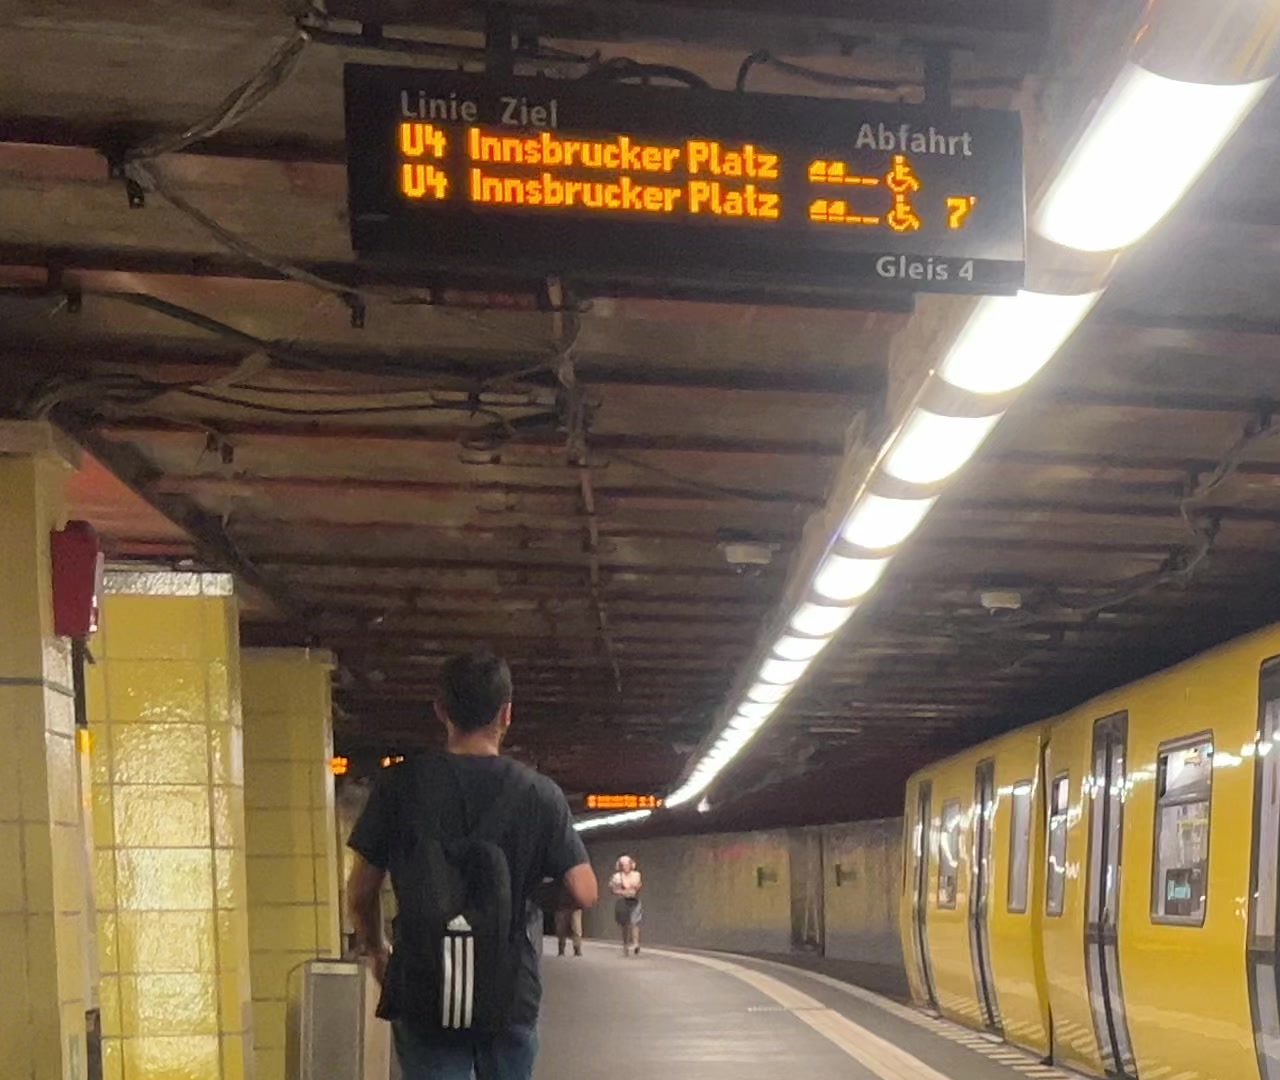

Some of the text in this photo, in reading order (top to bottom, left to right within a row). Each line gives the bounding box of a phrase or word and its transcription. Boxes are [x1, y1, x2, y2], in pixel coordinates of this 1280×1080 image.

[400, 89, 973, 157] Linie Ziel Abfahrt
[401, 122, 779, 179] U4 Innsbrucker Platz
[402, 163, 448, 200] U4
[470, 167, 681, 212] Innsbrucker
[688, 180, 780, 219] Platz
[876, 255, 974, 281] Gleis 4
